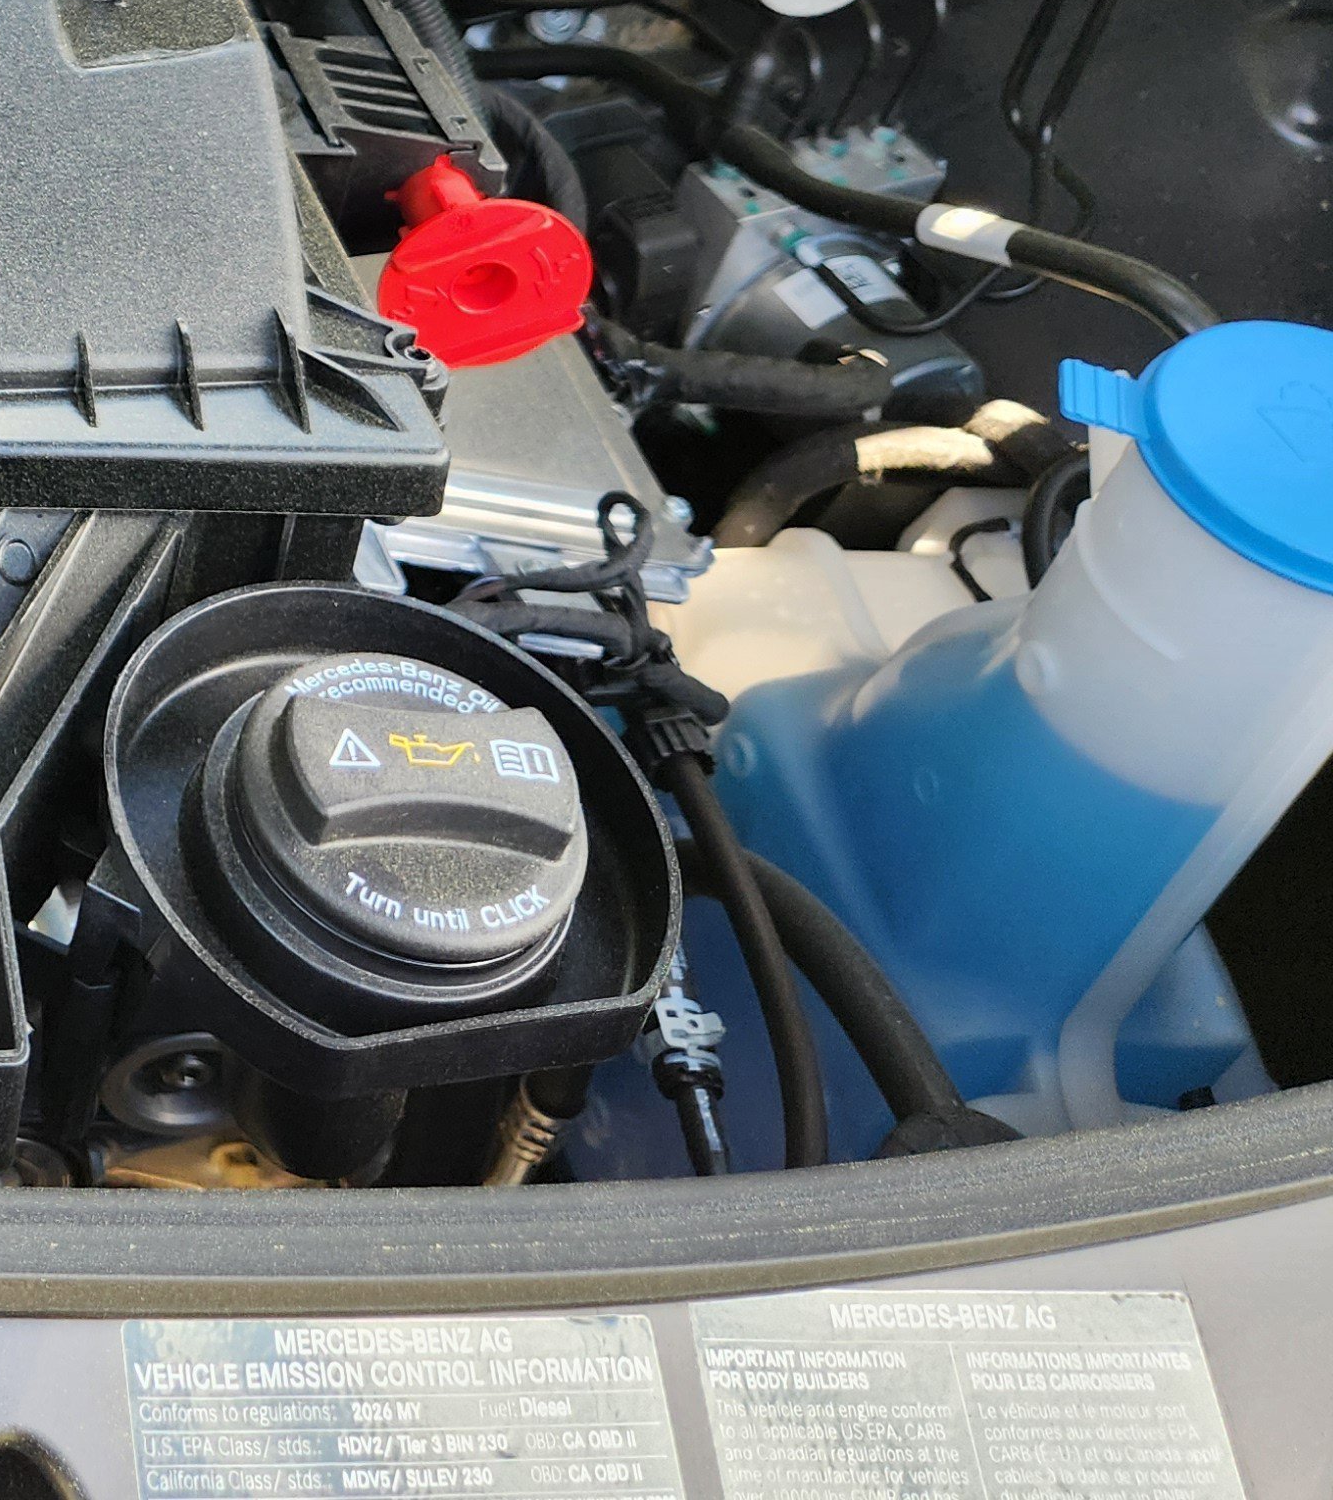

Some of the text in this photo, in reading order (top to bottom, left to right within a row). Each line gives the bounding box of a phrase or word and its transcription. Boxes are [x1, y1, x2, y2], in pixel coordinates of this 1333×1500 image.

[284, 659, 501, 713] Mercedes-Benz Oil
[346, 872, 550, 931] Turn until CLICK
[829, 1303, 1056, 1330] MERCEDES-BENZ AG
[274, 1326, 513, 1355] MERCEDES-BENZ AG
[706, 1348, 907, 1370] IMPORTANT INFORMATION
[965, 1351, 1193, 1371] INFORMATIONS IMPORTANTES
[134, 1355, 653, 1390] VEHICLE EMISSION CONTROL INFORMATION
[709, 1369, 870, 1390] FOR BODY BUILDERS
[970, 1372, 1156, 1391] POUR LES CARROSSIERS
[139, 1396, 572, 1426] Conforms to regulations: 2026 MY Fuel: Diesel
[717, 1398, 952, 1422] This vehicle and engine conform
[978, 1402, 994, 1419] Le
[1000, 1401, 1060, 1419] véhicule
[1099, 1403, 1150, 1419] moteur
[1154, 1402, 1187, 1419] sont
[720, 1423, 734, 1439] to
[741, 1423, 757, 1440] all
[763, 1424, 837, 1443] applicable
[842, 1424, 863, 1440] US
[904, 1423, 946, 1440] CARB
[984, 1423, 1062, 1441] conformes
[1096, 1422, 1168, 1441] directives
[143, 1435, 178, 1457] U.S.
[182, 1435, 211, 1456] EPA
[217, 1435, 270, 1458] Class/
[337, 1435, 393, 1458] HDV2/
[396, 1434, 428, 1454] Tier
[431, 1434, 442, 1454] 3
[446, 1434, 474, 1451] BIN
[477, 1432, 508, 1451] 230
[562, 1430, 586, 1449] CA
[588, 1429, 623, 1448] OBD
[988, 1445, 1031, 1463] CARB
[725, 1445, 959, 1466] and Canadian regulations at the
[146, 1469, 224, 1492] California
[228, 1469, 281, 1493] Class/
[342, 1468, 403, 1493] MDV5/
[406, 1469, 458, 1488] SULEV
[461, 1467, 493, 1486] 230
[568, 1464, 593, 1483] CA
[595, 1463, 629, 1482] OBD
[767, 1466, 970, 1486] of manufacture for vehicles
[994, 1468, 1043, 1485] cables
[1078, 1469, 1110, 1485] date
[1136, 1468, 1216, 1488] production
